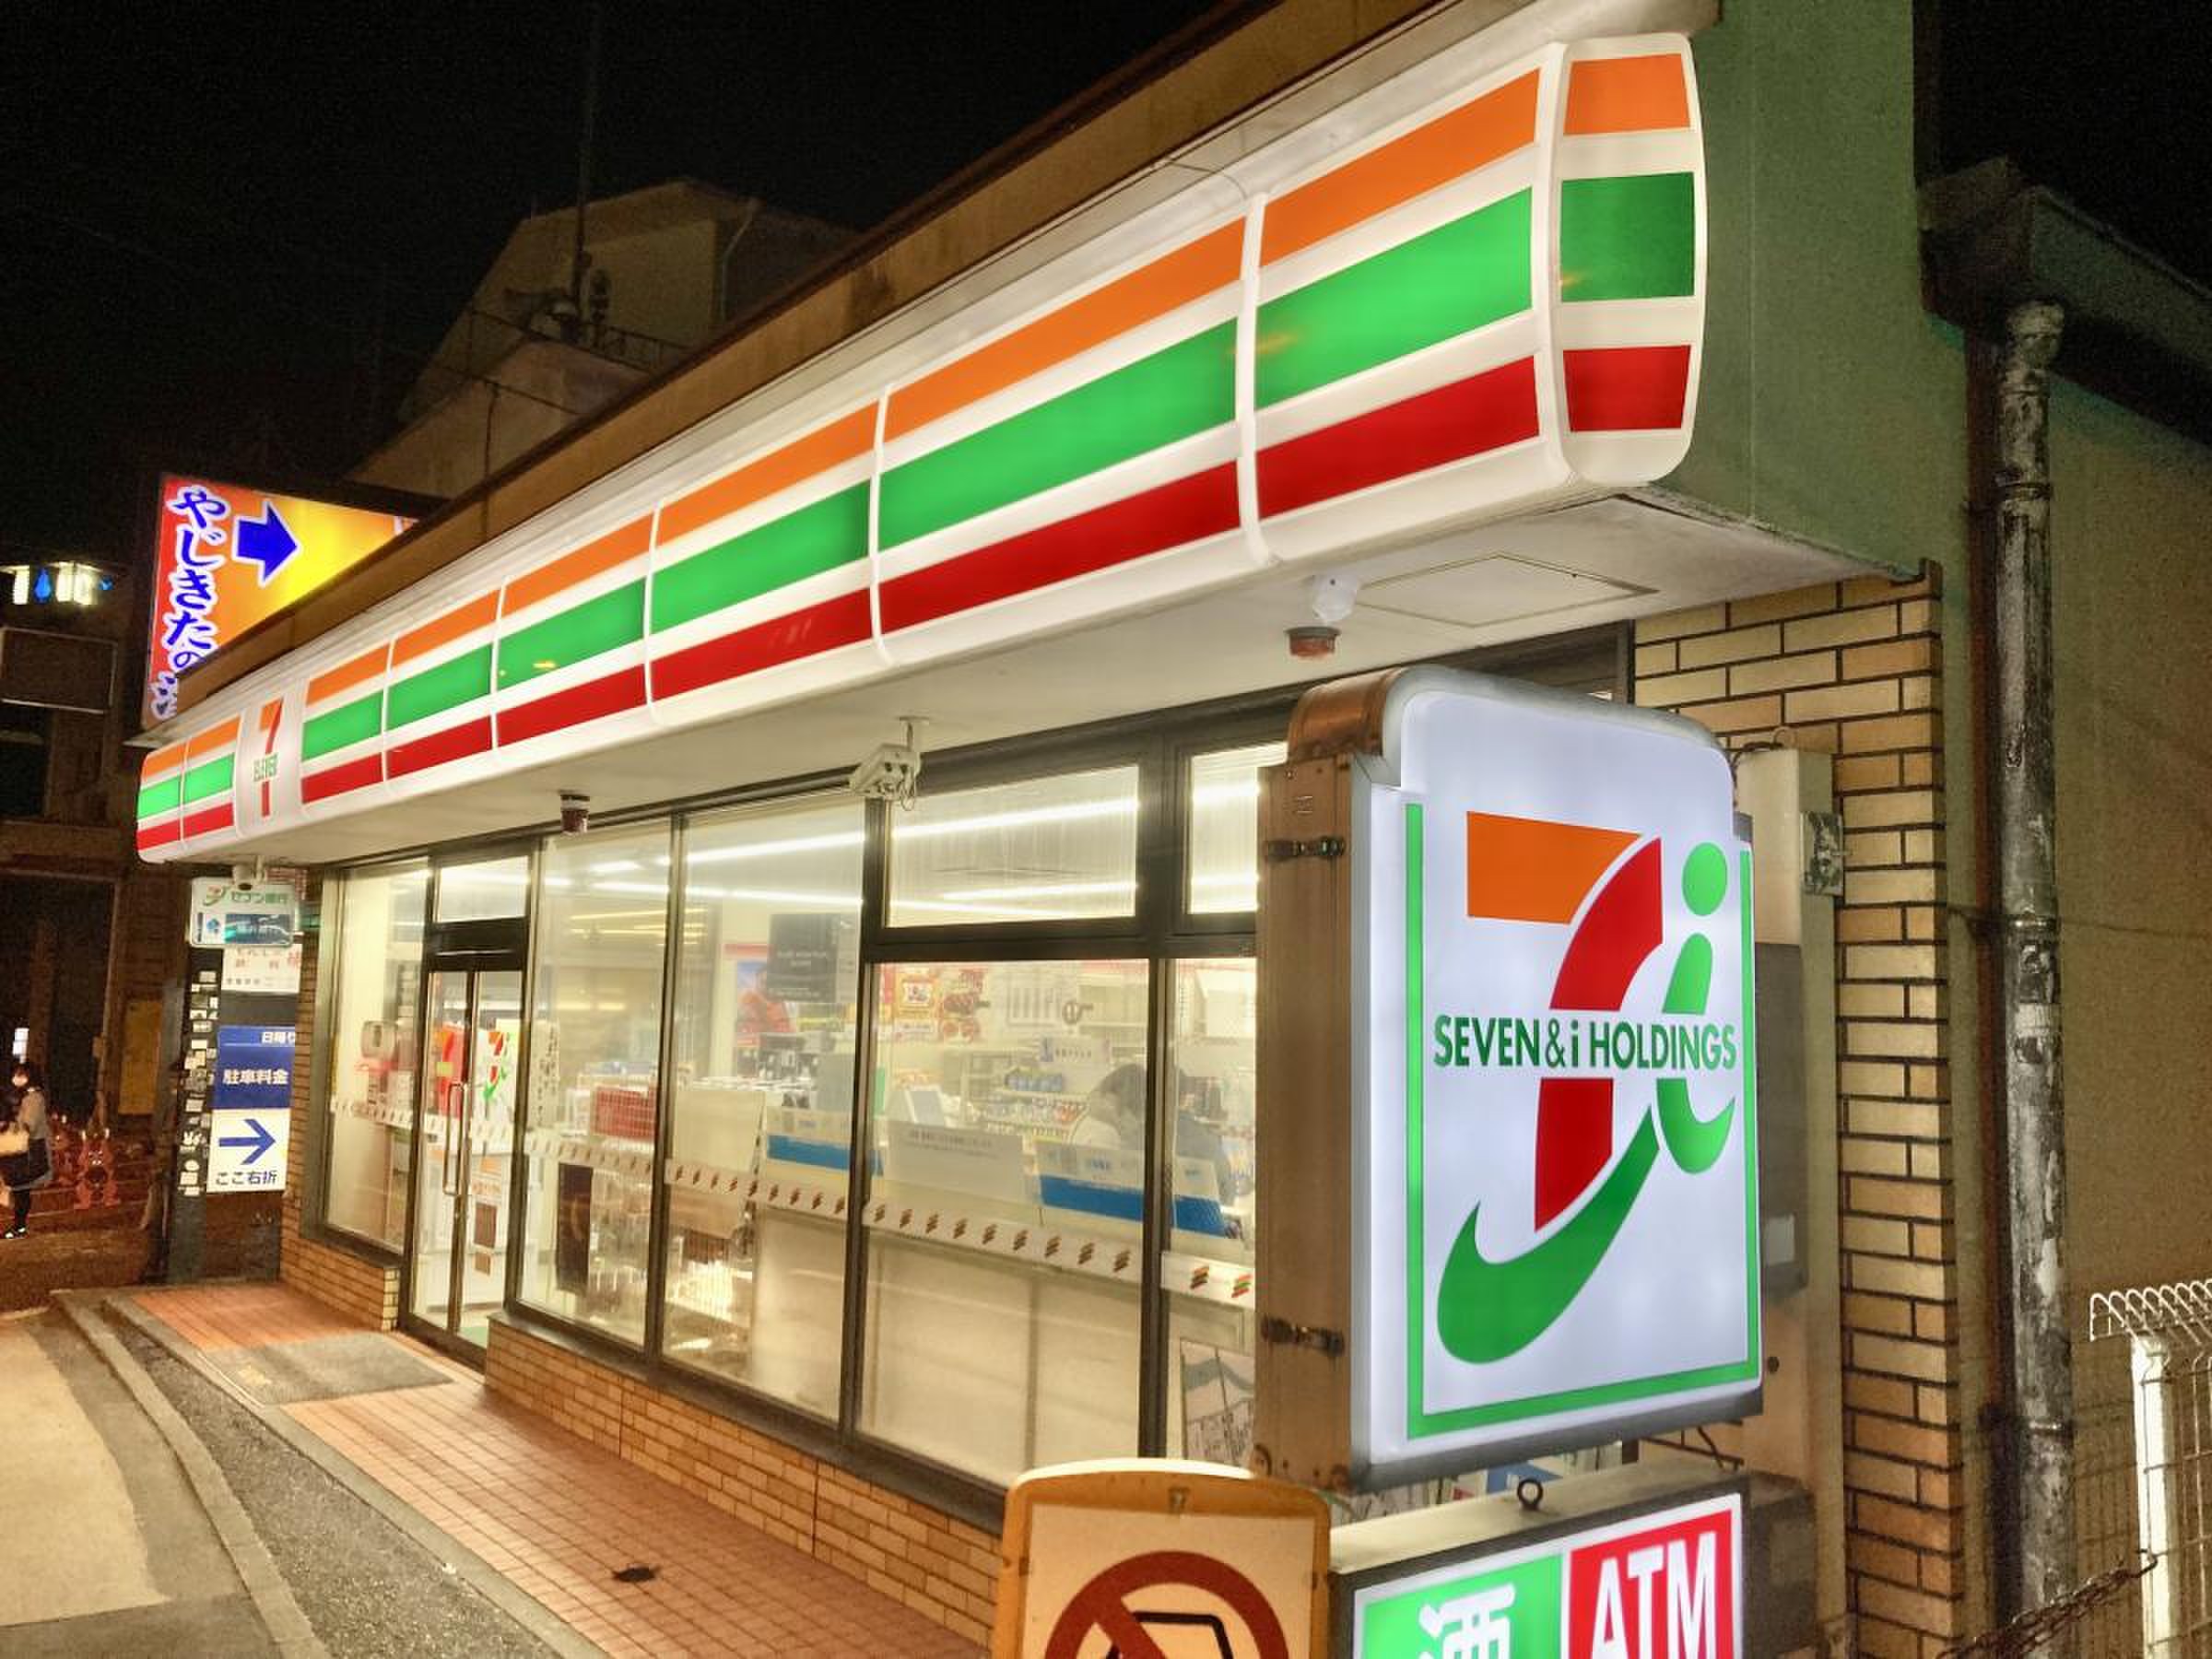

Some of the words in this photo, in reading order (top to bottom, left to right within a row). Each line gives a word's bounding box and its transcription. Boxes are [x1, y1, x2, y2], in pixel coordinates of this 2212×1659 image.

[154, 488, 227, 715] やじきたの
[1590, 1022, 1737, 1070] HOLDINGS
[222, 1069, 288, 1085] 駐車料金
[215, 1169, 277, 1185] ここ右折
[1592, 1531, 1716, 1659] ATM
